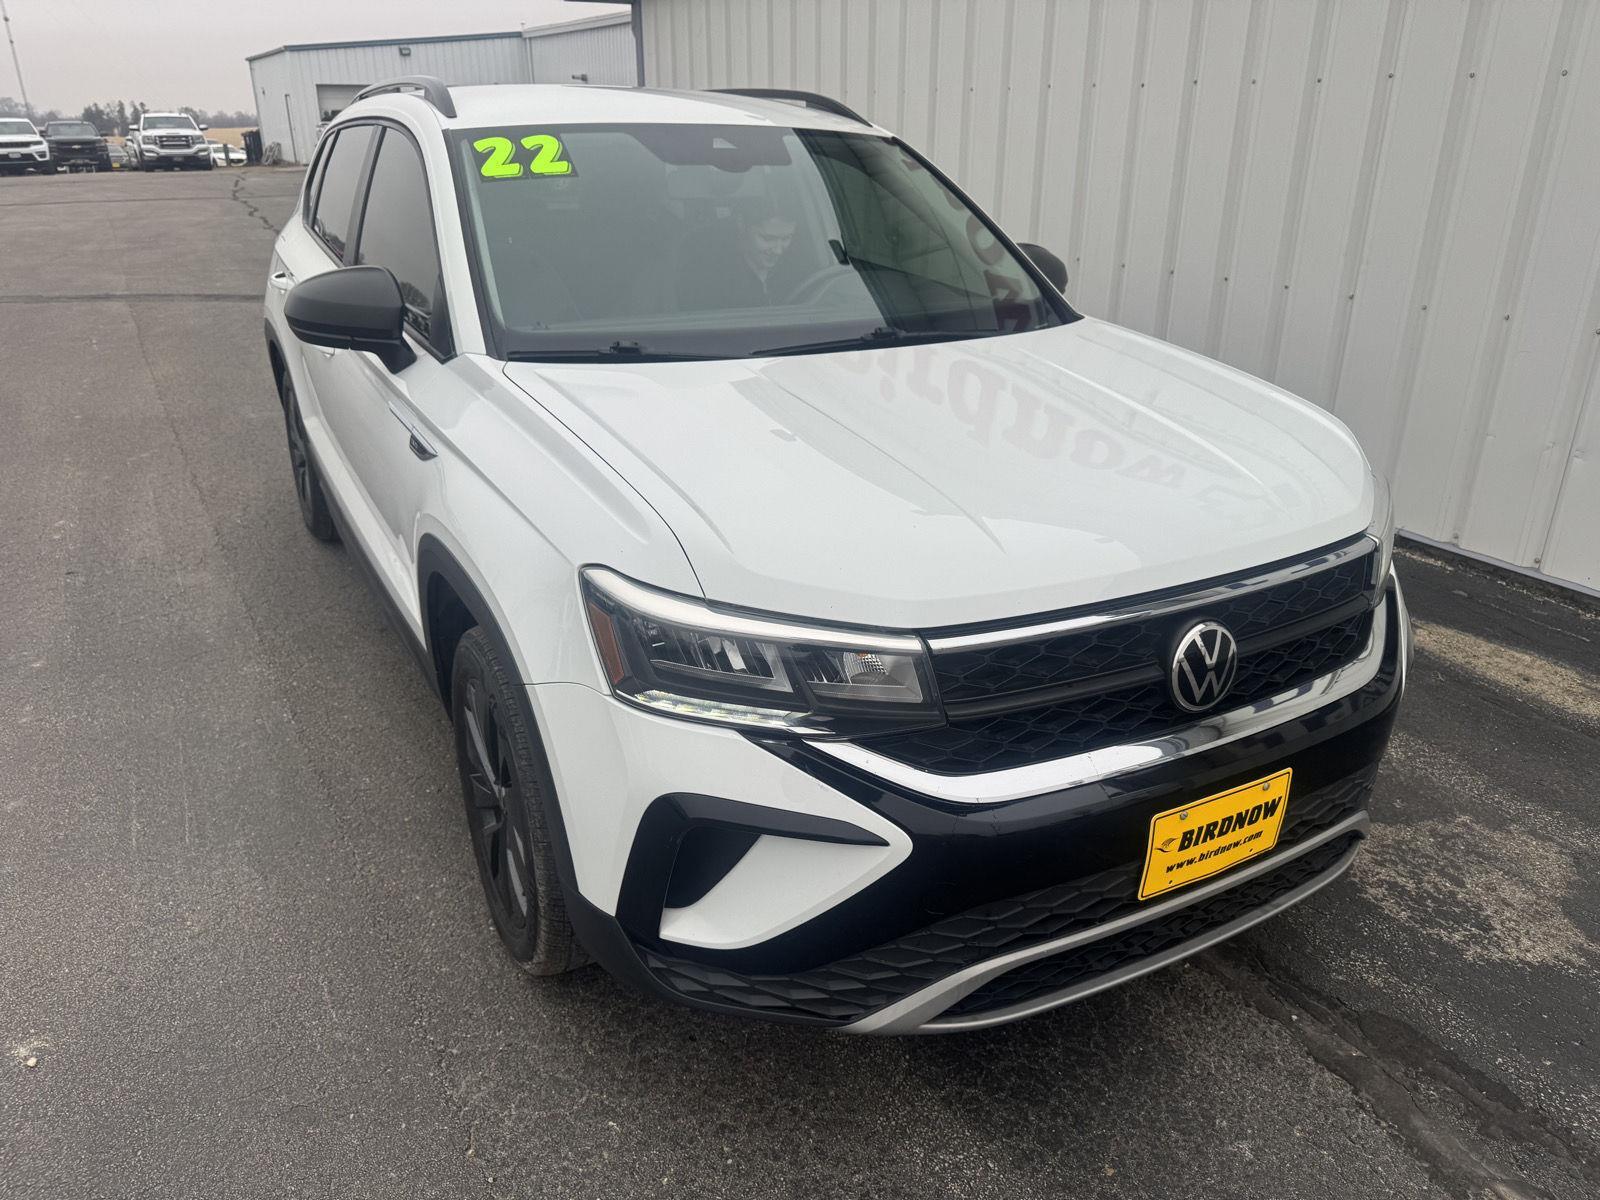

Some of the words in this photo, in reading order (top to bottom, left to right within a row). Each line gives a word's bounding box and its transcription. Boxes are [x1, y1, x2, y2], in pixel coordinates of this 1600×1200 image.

[473, 135, 572, 178] 22
[1173, 622, 1237, 710] VW
[1177, 796, 1282, 852] BIRDNOW
[1165, 830, 1264, 873] www.birdnow.com
